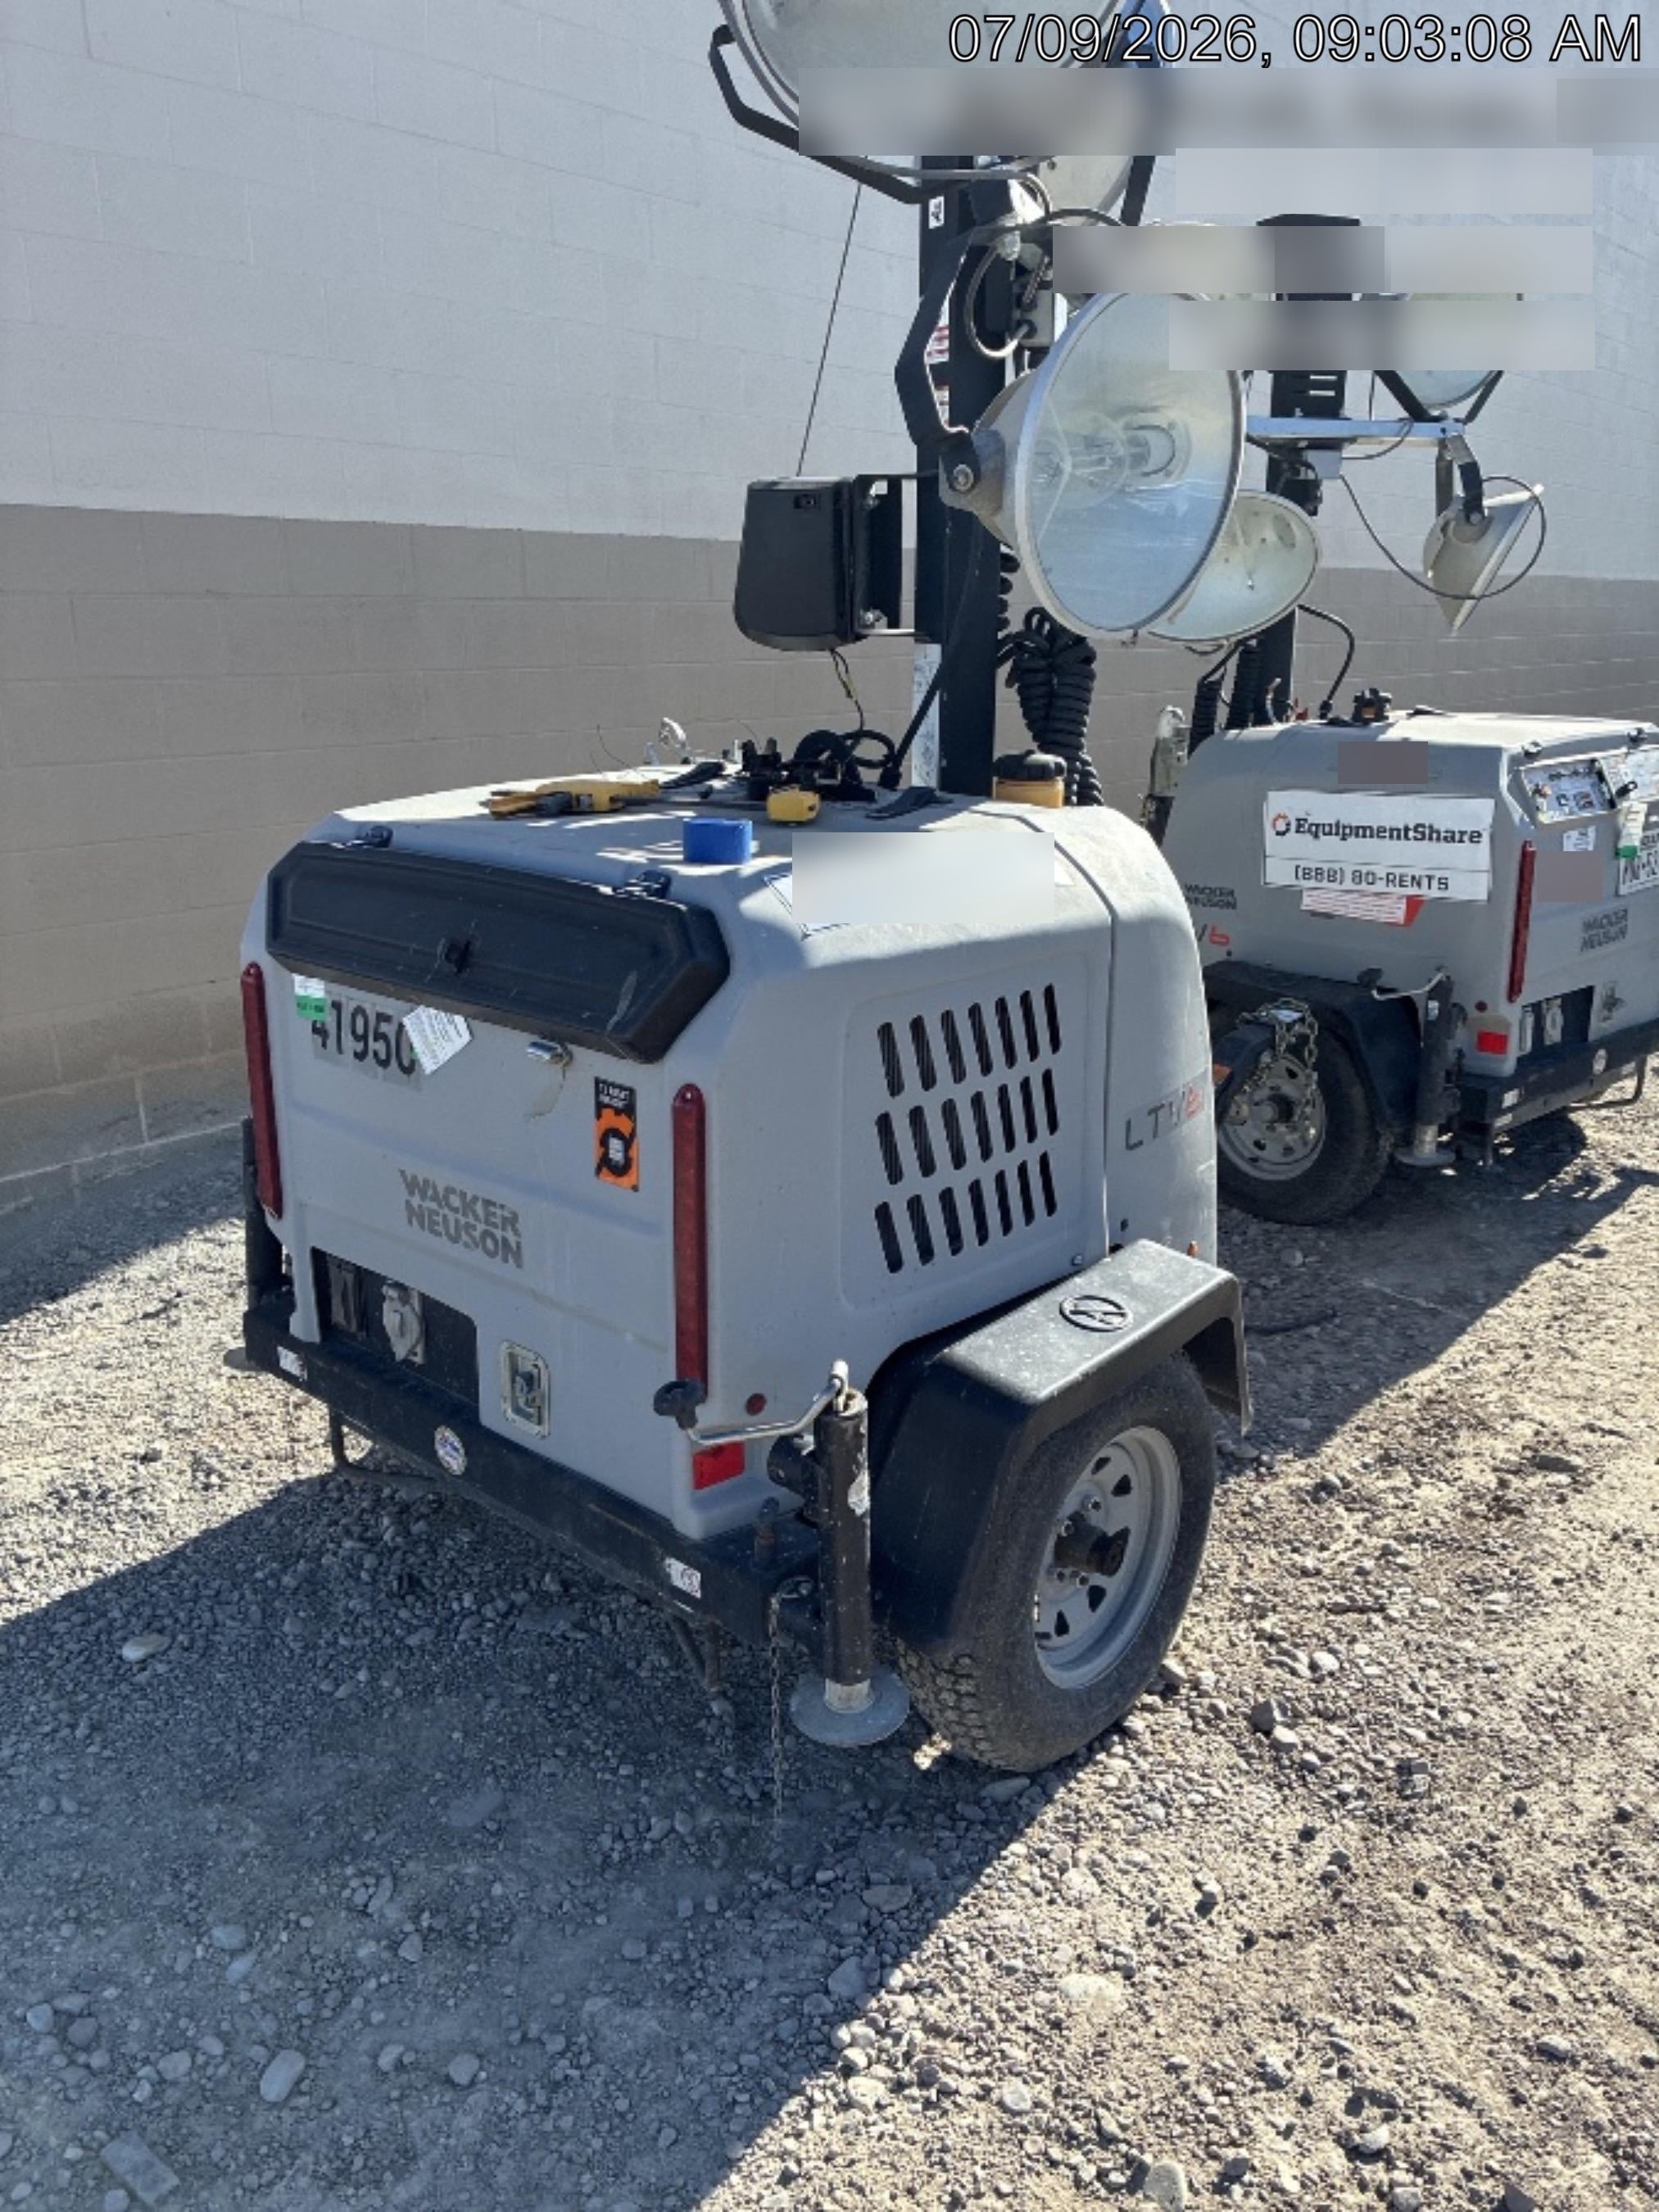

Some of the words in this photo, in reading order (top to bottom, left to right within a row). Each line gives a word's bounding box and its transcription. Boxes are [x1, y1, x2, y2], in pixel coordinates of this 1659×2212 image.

[1294, 818, 1483, 845] EquipmentShare
[1352, 870, 1450, 891] 80-RENTS
[398, 1167, 522, 1239] WACKER
[405, 1198, 524, 1269] NEUSON
